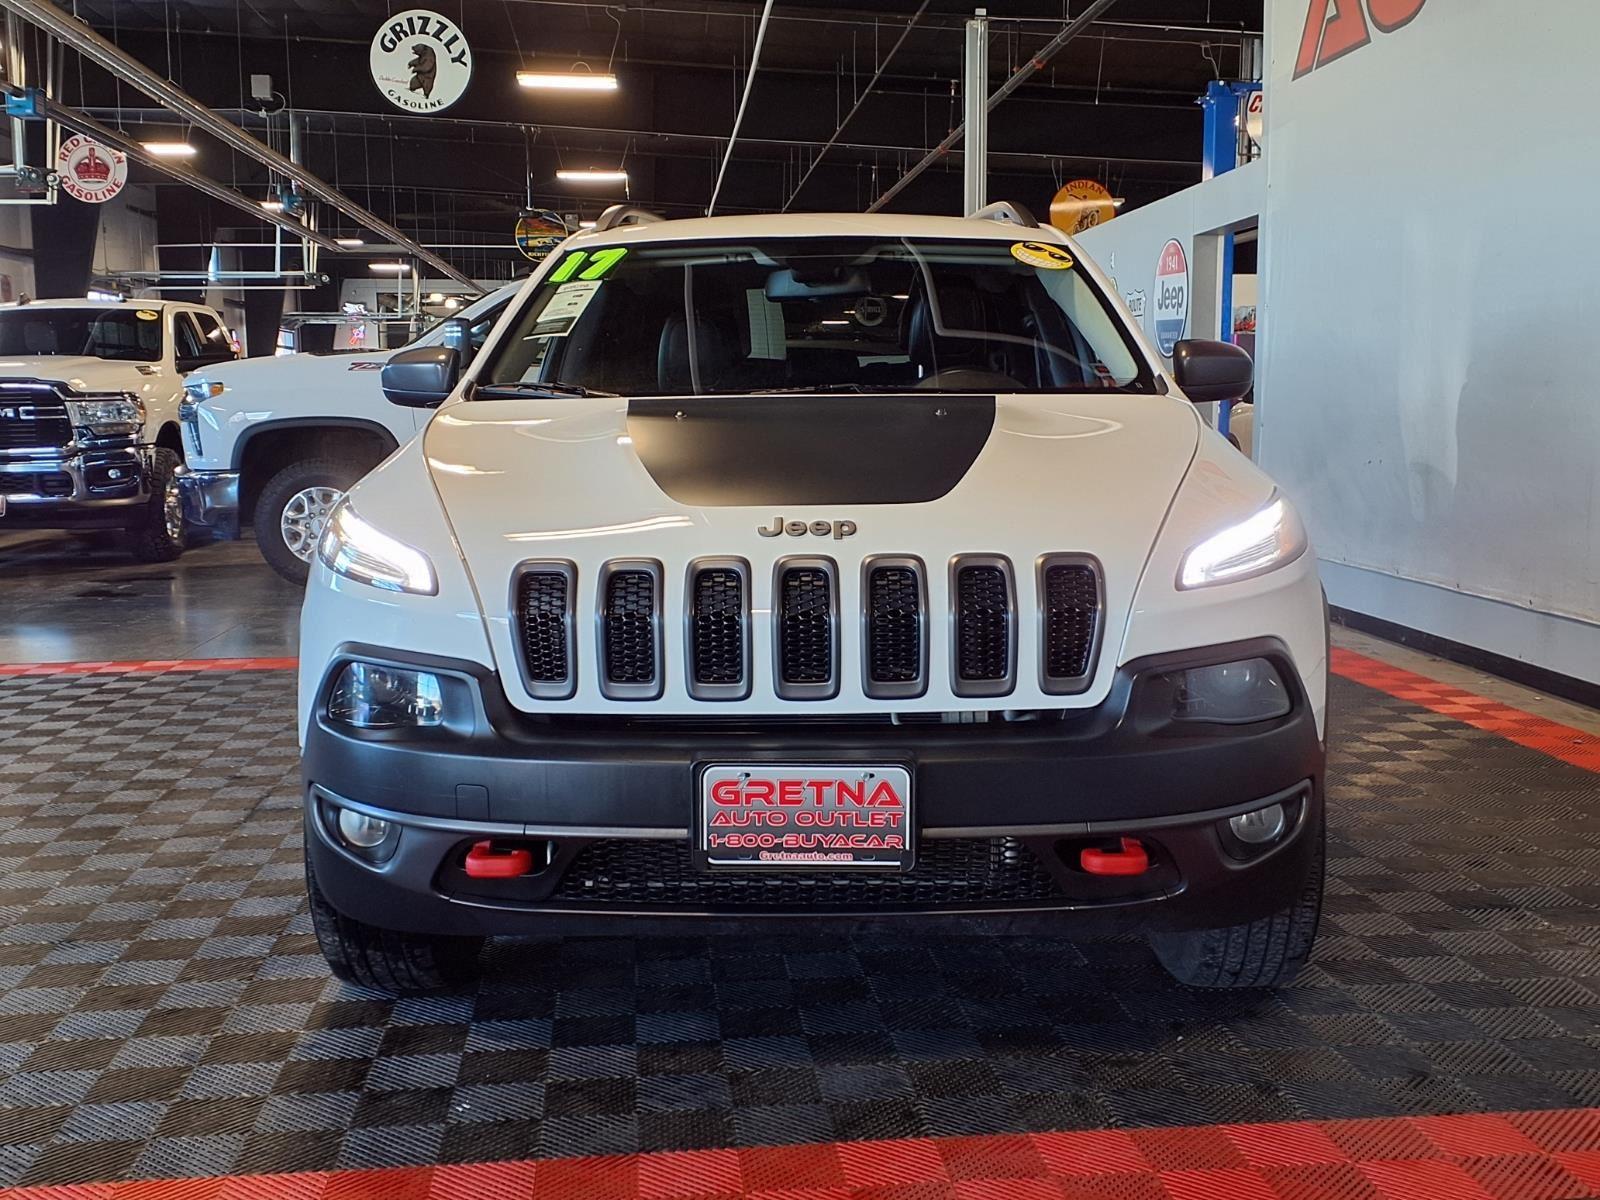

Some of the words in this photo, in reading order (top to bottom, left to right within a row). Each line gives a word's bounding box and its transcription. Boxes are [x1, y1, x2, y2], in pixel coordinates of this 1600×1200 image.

[380, 15, 468, 68] GRIZZLY
[387, 89, 445, 110] GASOLINE
[59, 137, 80, 162] RED
[60, 174, 123, 201] GASOLINE
[1065, 181, 1105, 195] INDIAN
[548, 247, 628, 283] 17
[1157, 280, 1184, 316] Jeep
[757, 516, 857, 540] Jeep
[711, 779, 904, 808] GRETNA
[709, 810, 788, 827] AUTO
[795, 810, 904, 827] OUTLET
[708, 833, 904, 849] 1-800-BUYACAR
[759, 850, 854, 862] Gretnaauto.com
